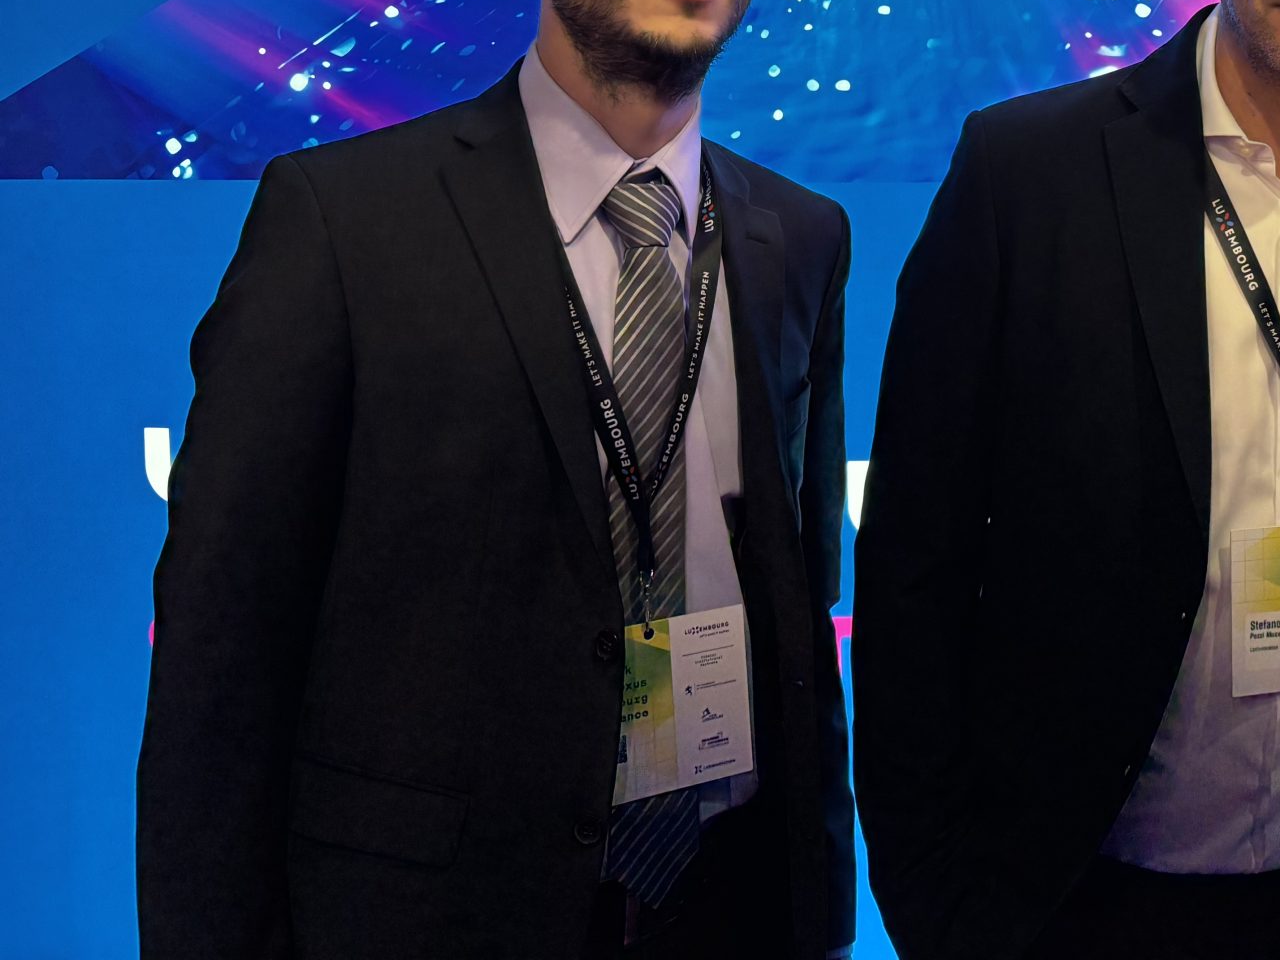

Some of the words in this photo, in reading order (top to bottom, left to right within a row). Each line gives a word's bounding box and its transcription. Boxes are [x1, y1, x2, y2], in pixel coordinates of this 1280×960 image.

[1211, 198, 1259, 291] LUXEMBOURG
[698, 271, 710, 309] HAPPEN
[1258, 302, 1273, 327] LET'S
[576, 330, 593, 359] MAKE
[694, 323, 704, 350] MAKE
[587, 359, 603, 386] LET'S
[687, 352, 698, 379] LET'S
[600, 398, 640, 500] LUXEMBOURG
[684, 621, 729, 635] LUXEMBOURG
[1250, 620, 1280, 631] Stefano
[625, 679, 647, 691] xus
